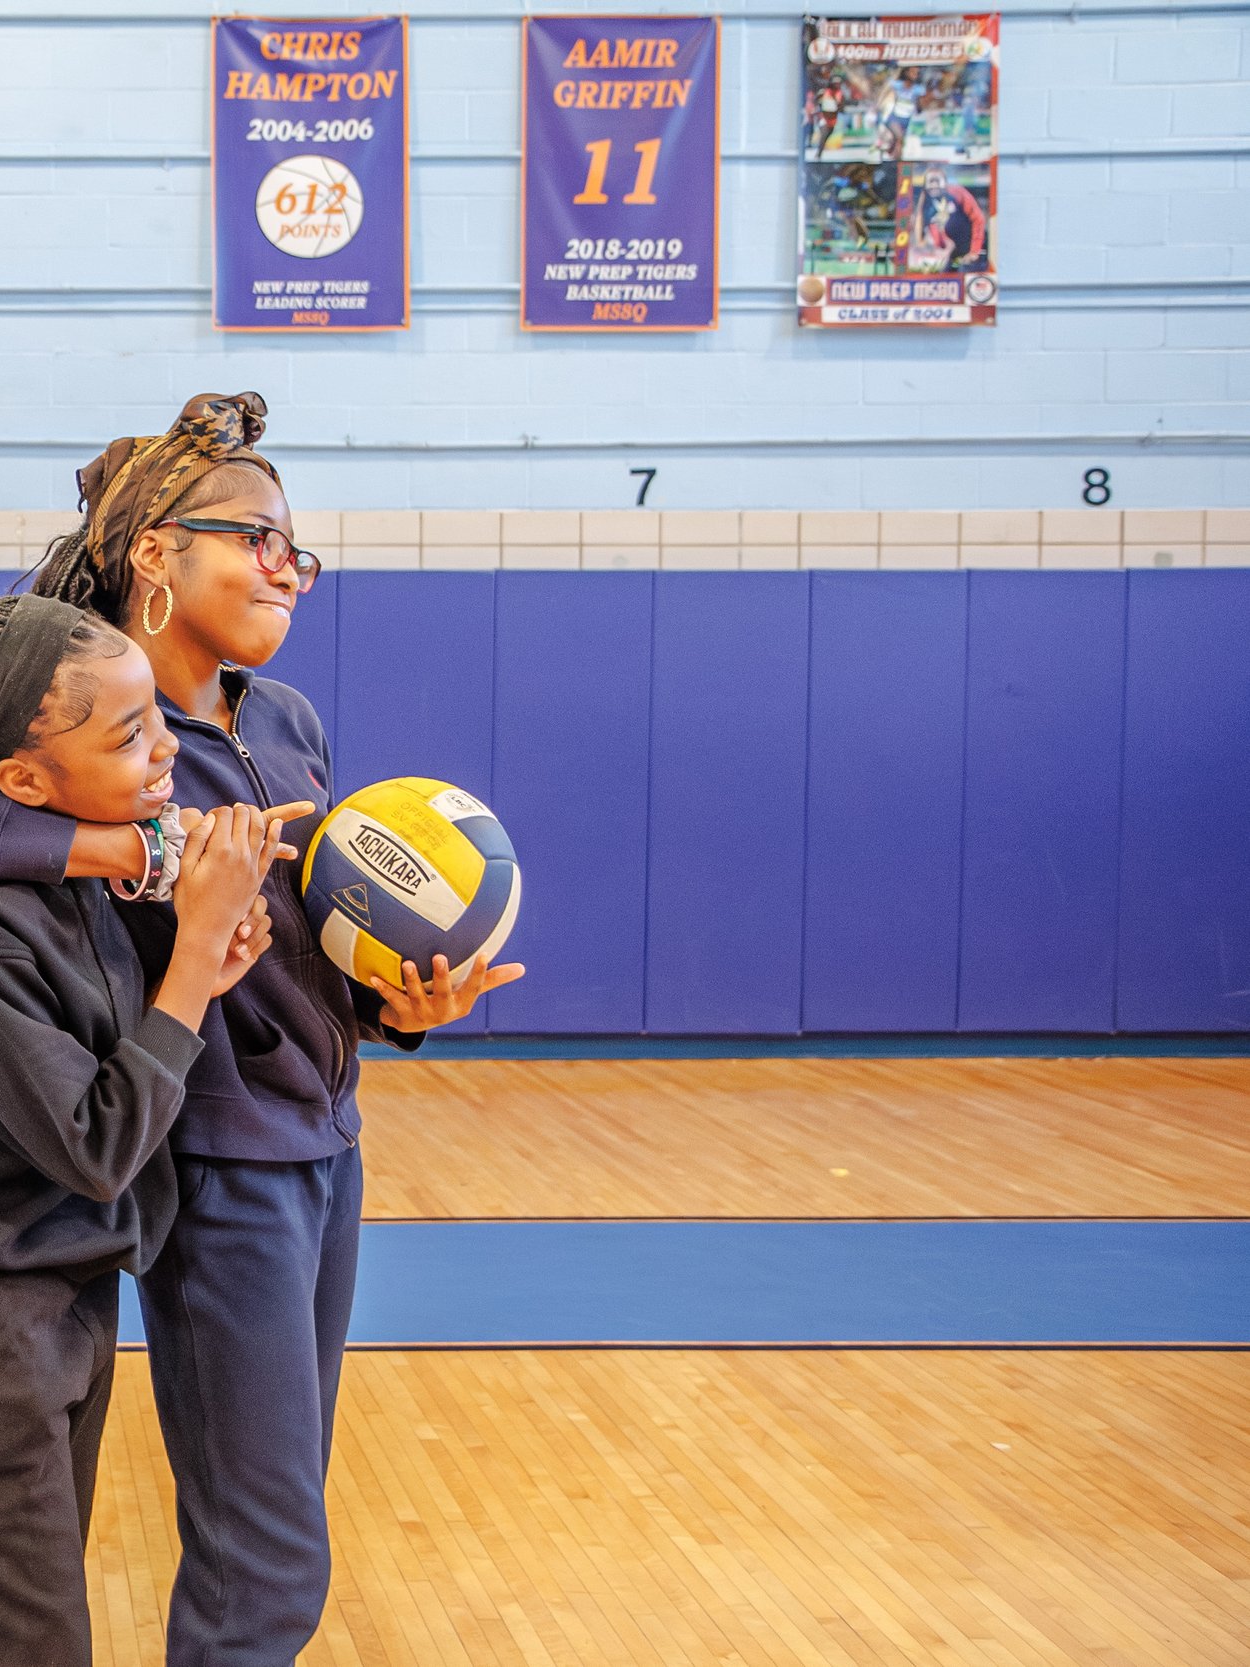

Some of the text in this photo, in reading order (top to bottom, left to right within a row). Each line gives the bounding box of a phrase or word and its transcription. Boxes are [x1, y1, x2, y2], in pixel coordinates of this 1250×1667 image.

[260, 32, 362, 61] CHRIS
[563, 39, 679, 69] AAMIR
[224, 70, 398, 102] HAMPTON
[553, 79, 693, 109] GRIFFIN
[246, 118, 374, 142] 2004-2006
[573, 138, 662, 205] 11
[275, 182, 346, 215] 612
[279, 224, 341, 239] POINTS
[565, 238, 682, 261] 2018-2019
[544, 264, 697, 281] NEW PREP TIGERS
[252, 280, 370, 294] NEW PREP TIGERS
[566, 284, 675, 301] BASKETBALL
[831, 281, 867, 301] NEW
[870, 281, 911, 301] PREP
[255, 296, 367, 309] LEADING SCORER
[592, 303, 648, 322] MS8Q
[838, 308, 889, 321] CLASS
[630, 468, 656, 506] 7
[1083, 468, 1110, 505] 8
[354, 825, 422, 890] TACHIKARA
